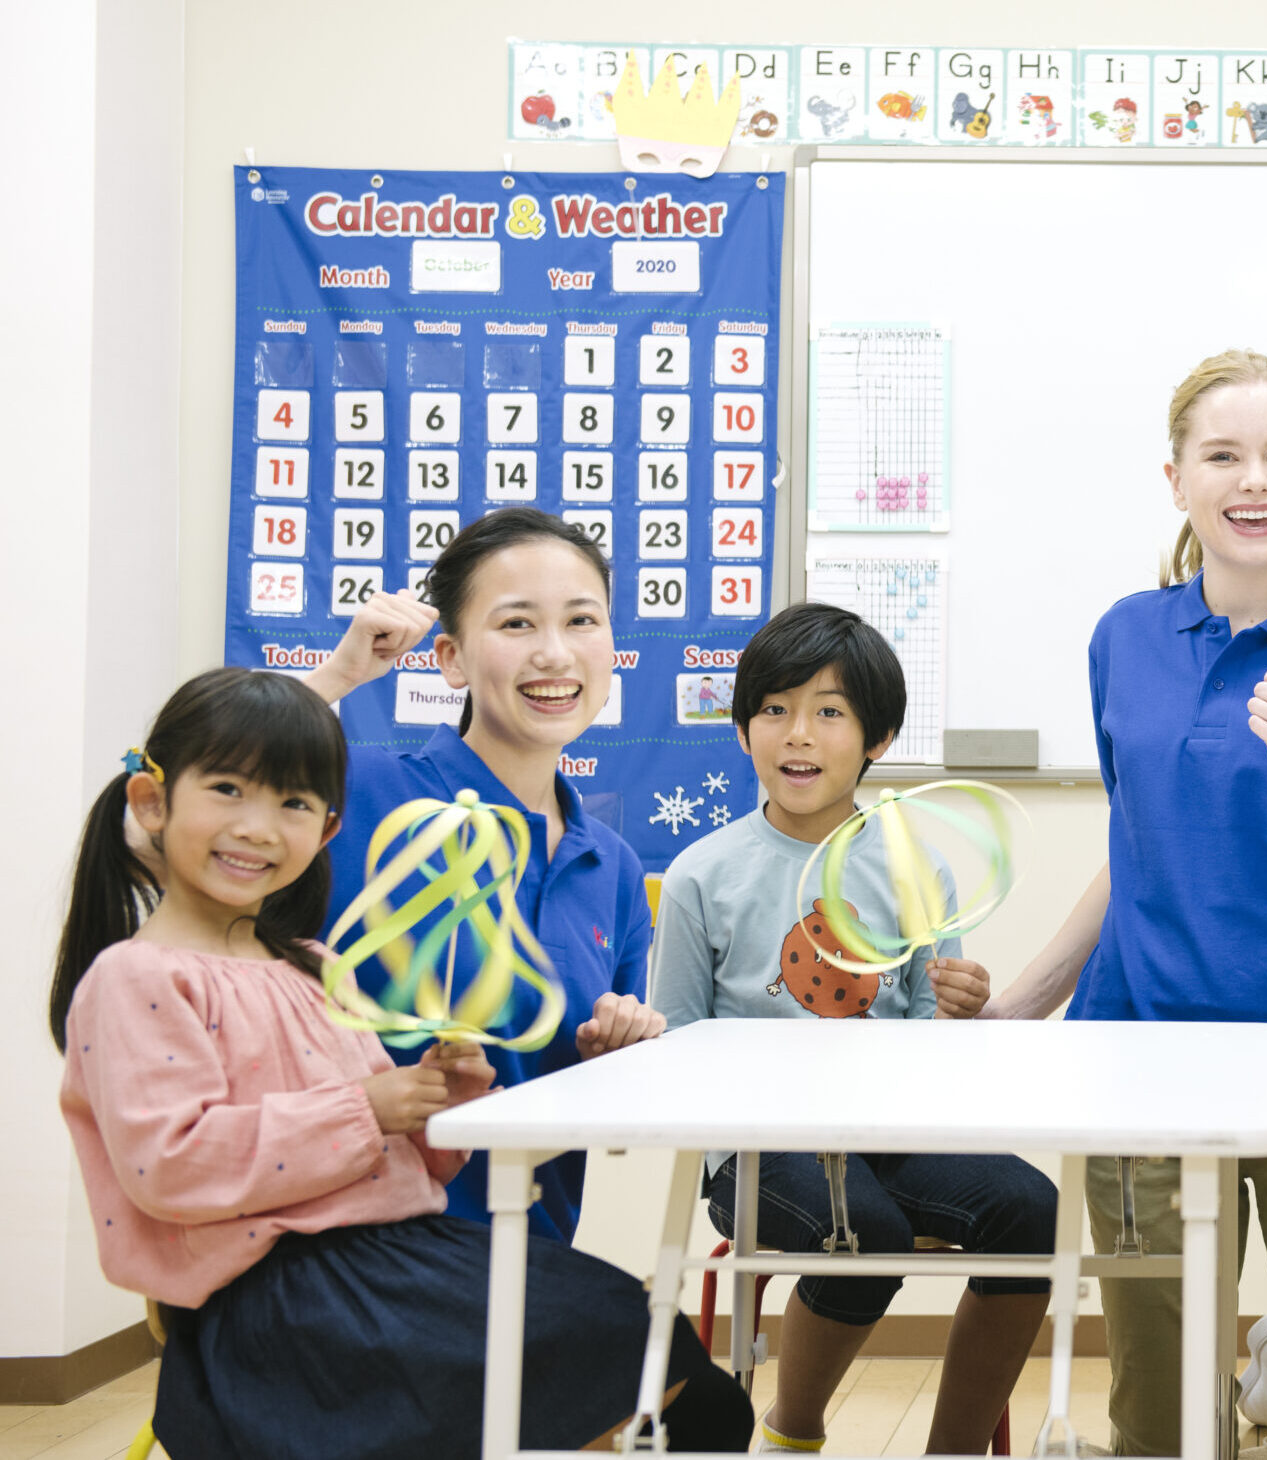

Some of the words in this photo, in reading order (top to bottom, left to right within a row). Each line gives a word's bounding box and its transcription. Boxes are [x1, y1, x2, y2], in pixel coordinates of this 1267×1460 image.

[597, 51, 629, 76] B
[735, 54, 776, 79] Dd
[816, 50, 852, 76] Ee
[884, 50, 921, 77] Ff
[948, 52, 992, 90] Gg
[1019, 53, 1059, 79] Hh
[1105, 57, 1125, 84] Ii
[1165, 58, 1201, 96] Jj
[308, 196, 495, 236] Calendar
[509, 196, 545, 237] &
[554, 197, 725, 237] Weather
[320, 266, 390, 289] Month
[549, 270, 594, 291] Year
[635, 259, 677, 274] 2020
[264, 320, 306, 334] Sunday
[340, 320, 383, 334] Monday
[415, 322, 461, 336] Tuesday
[485, 322, 547, 337] Wednesday
[566, 321, 618, 336] Thursday
[652, 322, 687, 336] Friday
[719, 320, 767, 335] Saturday
[583, 347, 595, 375] 1
[655, 347, 674, 374] 2
[730, 347, 750, 374] 3
[272, 401, 294, 429] 4
[350, 403, 369, 431] 5
[425, 404, 445, 432] 6
[503, 405, 523, 432] 7
[579, 405, 599, 433] 8
[656, 405, 676, 433] 9
[721, 404, 756, 432] 10
[268, 458, 295, 487] 11
[343, 460, 375, 488] 12
[417, 462, 450, 490] 13
[494, 462, 529, 490] 14
[571, 463, 604, 491] 15
[647, 463, 679, 490] 16
[723, 462, 756, 490] 17
[263, 517, 297, 546] 18
[342, 520, 375, 548] 19
[415, 521, 455, 549] 20
[644, 521, 682, 549] 23
[718, 519, 758, 547] 24
[256, 575, 297, 601] 25
[338, 576, 374, 605] 26
[642, 579, 683, 607] 30
[719, 577, 752, 605] 31
[684, 646, 743, 668] Seas
